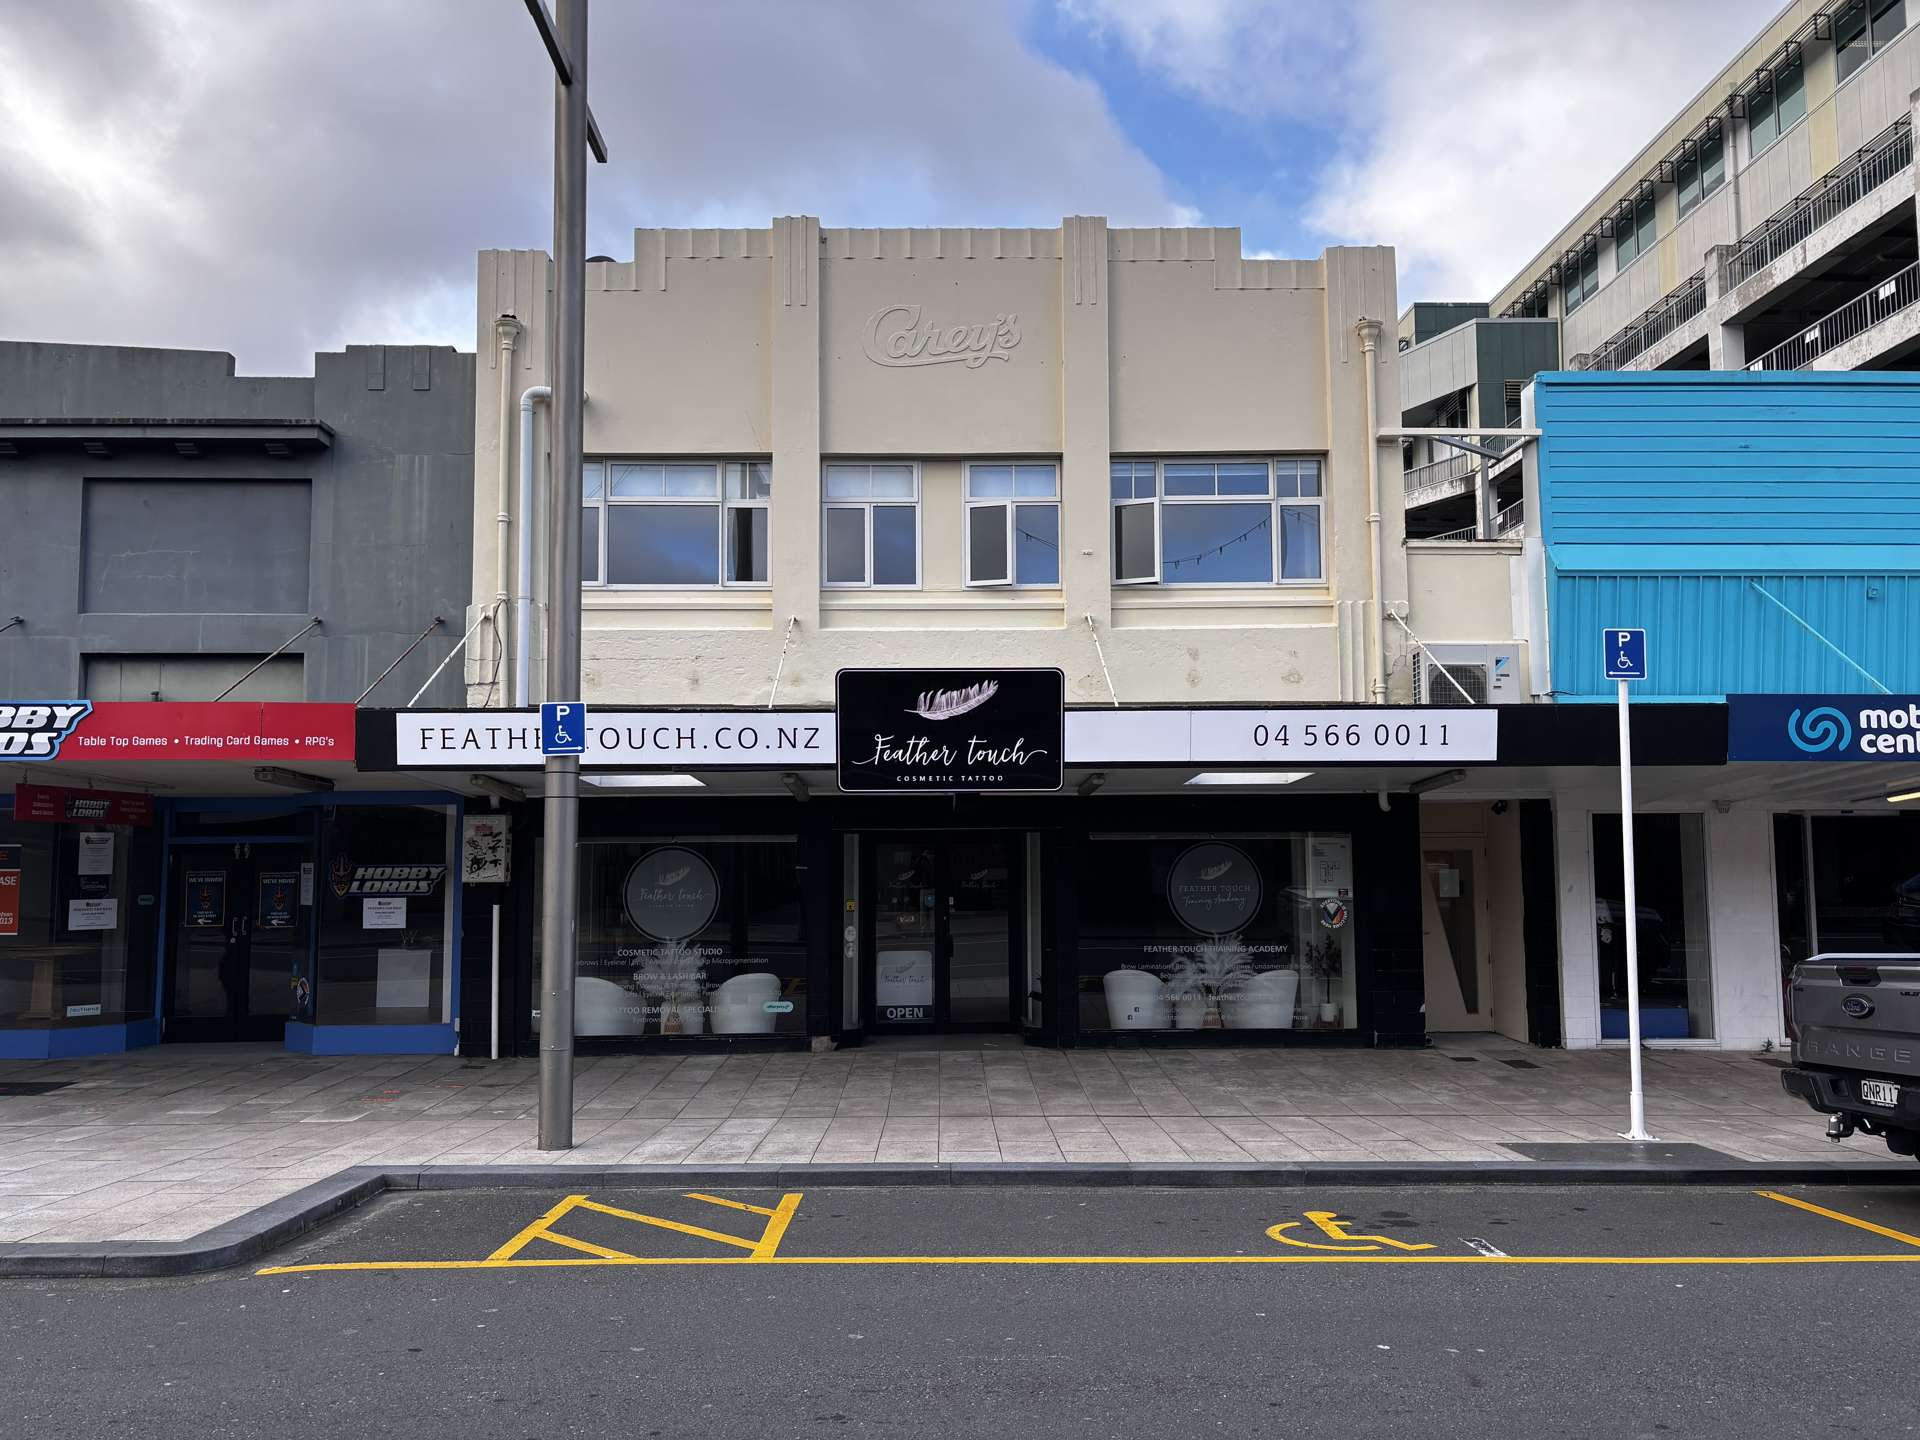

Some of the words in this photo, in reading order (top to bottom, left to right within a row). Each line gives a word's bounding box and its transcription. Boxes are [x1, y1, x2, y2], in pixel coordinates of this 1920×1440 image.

[863, 305, 1022, 369] Carey's
[1618, 631, 1631, 648] P
[556, 704, 570, 722] P
[1254, 724, 1289, 746] 04
[1304, 724, 1361, 746] 566
[1374, 724, 1449, 746] 0011
[78, 736, 106, 746] Table
[110, 736, 128, 748] Top
[132, 736, 168, 746] Games
[184, 736, 223, 748] Trading
[226, 736, 250, 746] Card
[254, 736, 289, 746] Games
[305, 737, 334, 747] RPG's
[852, 733, 958, 766] Feather
[968, 734, 1048, 766] touch
[896, 774, 953, 782] COSMETIC
[961, 774, 1004, 782] TATTOO
[74, 799, 111, 809] HOBBY
[72, 808, 105, 818] LORDS
[354, 867, 446, 880] HOBBY
[348, 880, 433, 893] LORDS
[1178, 884, 1217, 893] FEATHER
[1220, 884, 1251, 893] TOUCH
[617, 948, 658, 957] COSMETIC
[660, 948, 694, 957] TATTOO
[695, 947, 723, 956] STUDIO
[1143, 945, 1178, 953] FEATHER
[1180, 945, 1206, 953] TOUCH
[1248, 945, 1288, 953] ACADEMY
[886, 1007, 924, 1018] OPEN
